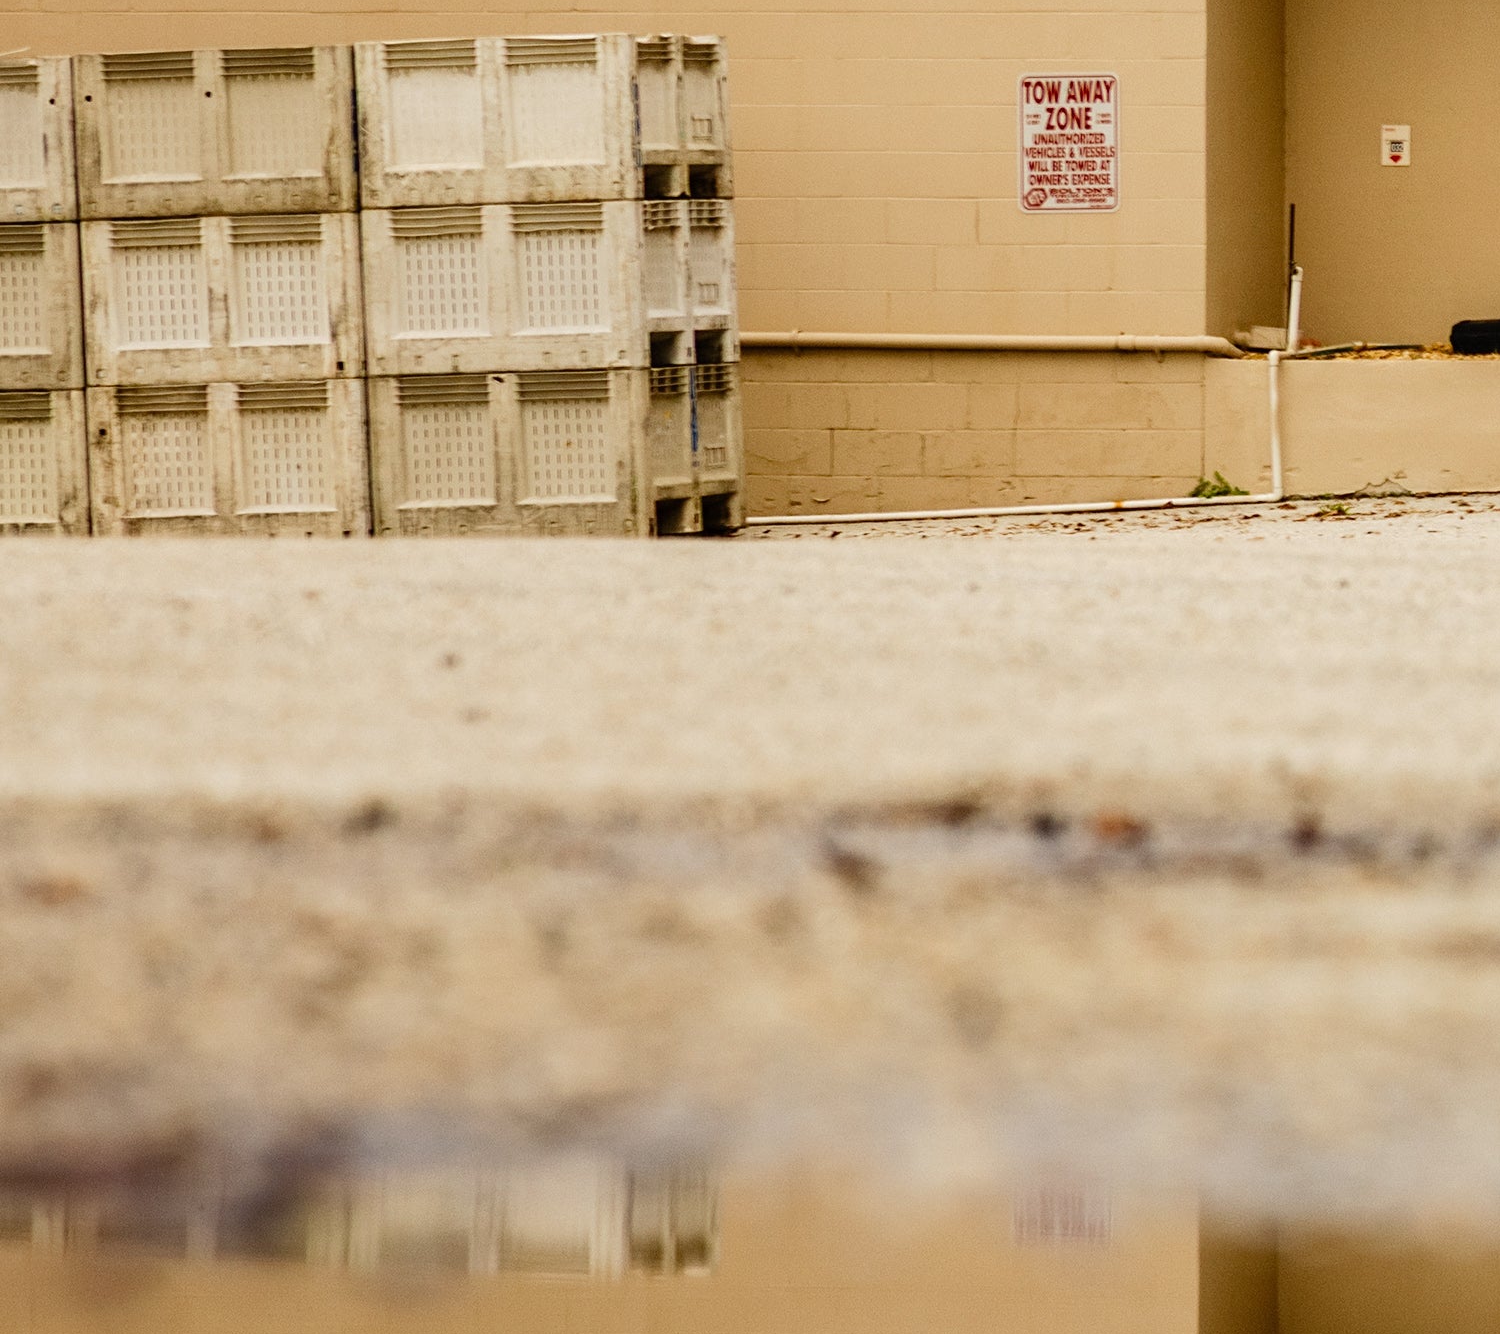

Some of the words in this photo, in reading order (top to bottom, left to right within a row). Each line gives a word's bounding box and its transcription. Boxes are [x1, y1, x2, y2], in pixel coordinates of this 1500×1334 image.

[1024, 81, 1061, 104] TOW
[1066, 80, 1115, 103] AWAY
[1045, 107, 1092, 130] ZONE
[1034, 133, 1106, 145] UNAUTHORIZED
[1026, 147, 1066, 158] VEHICLES
[1080, 147, 1115, 158] VESSELS
[1029, 160, 1049, 172] WILL
[1052, 160, 1063, 171] BE
[1065, 160, 1097, 171] TOWED
[1101, 160, 1110, 171] AT
[1029, 174, 1069, 186] OWNER'S
[1072, 173, 1111, 185] EXPENSE
